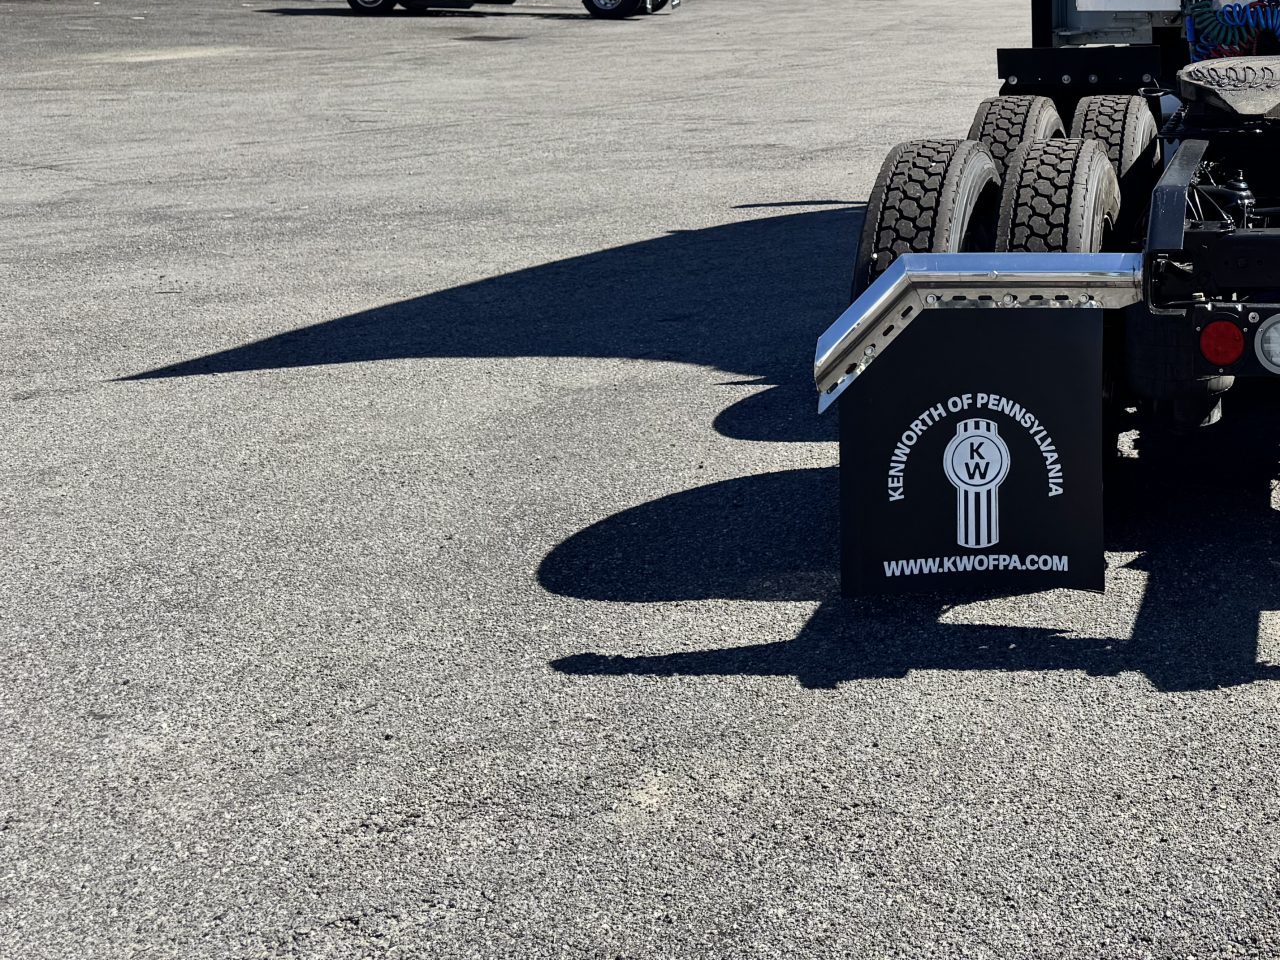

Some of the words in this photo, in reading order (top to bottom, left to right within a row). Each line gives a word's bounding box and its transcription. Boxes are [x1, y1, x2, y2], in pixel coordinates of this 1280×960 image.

[887, 402, 947, 502] KENWORTH
[947, 393, 973, 413] OF
[976, 392, 1064, 497] PENNSYLVANIA
[883, 554, 1069, 577] WWW.KWOFPA.COM
